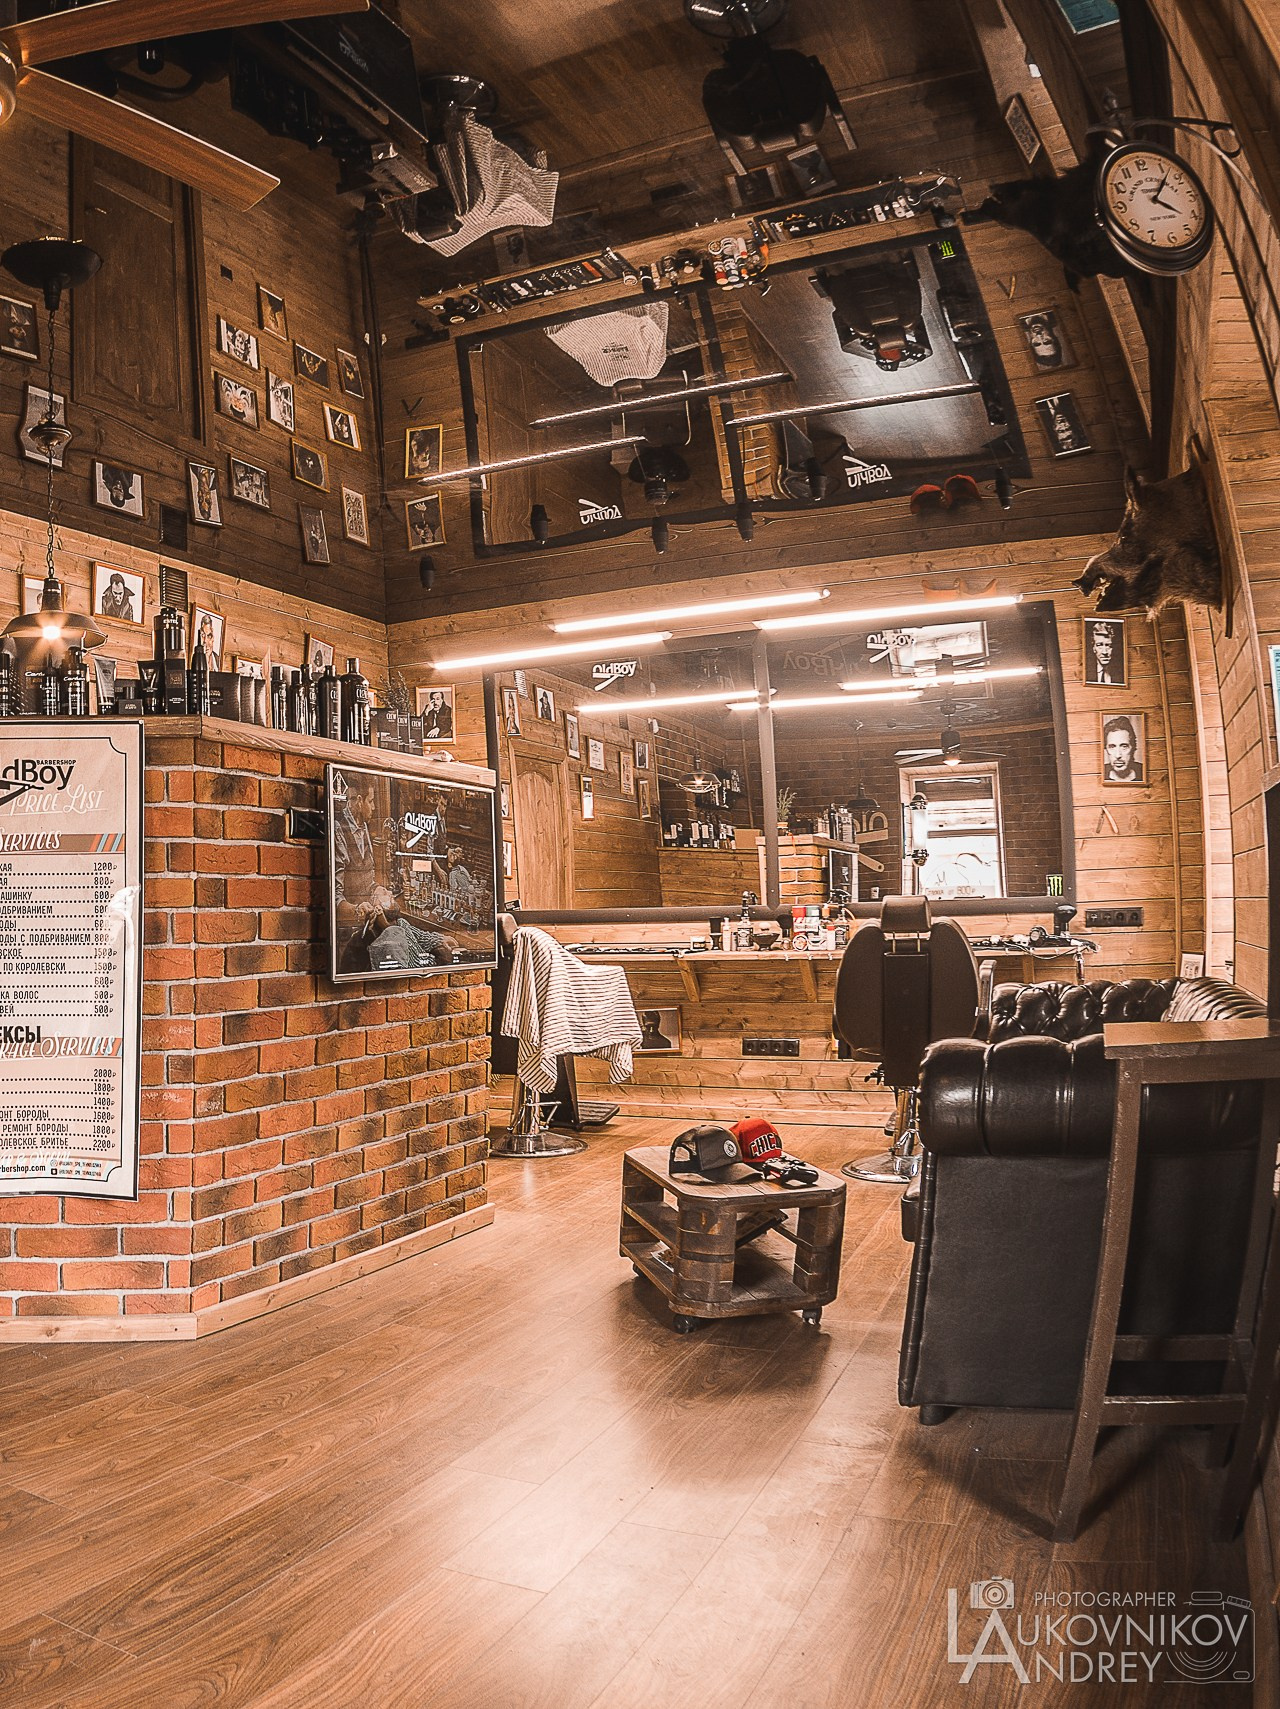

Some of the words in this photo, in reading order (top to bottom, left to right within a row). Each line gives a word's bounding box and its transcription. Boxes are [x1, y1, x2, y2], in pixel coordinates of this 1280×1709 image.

[1134, 158, 1149, 172] 12
[1157, 162, 1166, 174] 1
[1121, 167, 1132, 180] 11
[1173, 172, 1185, 186] 2
[1113, 181, 1127, 194] 10
[1128, 180, 1144, 202] GRAND
[1145, 177, 1179, 195] CENRAL
[1186, 190, 1197, 203] 3
[1113, 200, 1128, 214] 9
[1189, 209, 1200, 221] 4
[1128, 218, 1140, 231] 8
[1182, 223, 1193, 237] 5
[1147, 229, 1157, 243] 7
[1166, 231, 1178, 244] 6
[592, 660, 637, 678] OldBoy
[411, 720, 422, 728] CREW
[4, 786, 59, 816] PRICE
[62, 784, 108, 815] LIST
[404, 811, 438, 836] OldBoy
[20, 934, 26, 943] С
[29, 933, 91, 943] ПОДБРИВАНИЕМ
[3, 962, 14, 971] ПО
[15, 962, 66, 972] КОРОЛЕВСКИ
[13, 990, 39, 1000] ВОЛОС
[40, 1032, 114, 1059] SERVICES
[16, 1109, 49, 1120] БОРОДЫ
[2, 1123, 33, 1133] РЕМОНТ
[36, 1123, 69, 1133] БОРОДЫ
[40, 1137, 69, 1147] БРИТЬЕ
